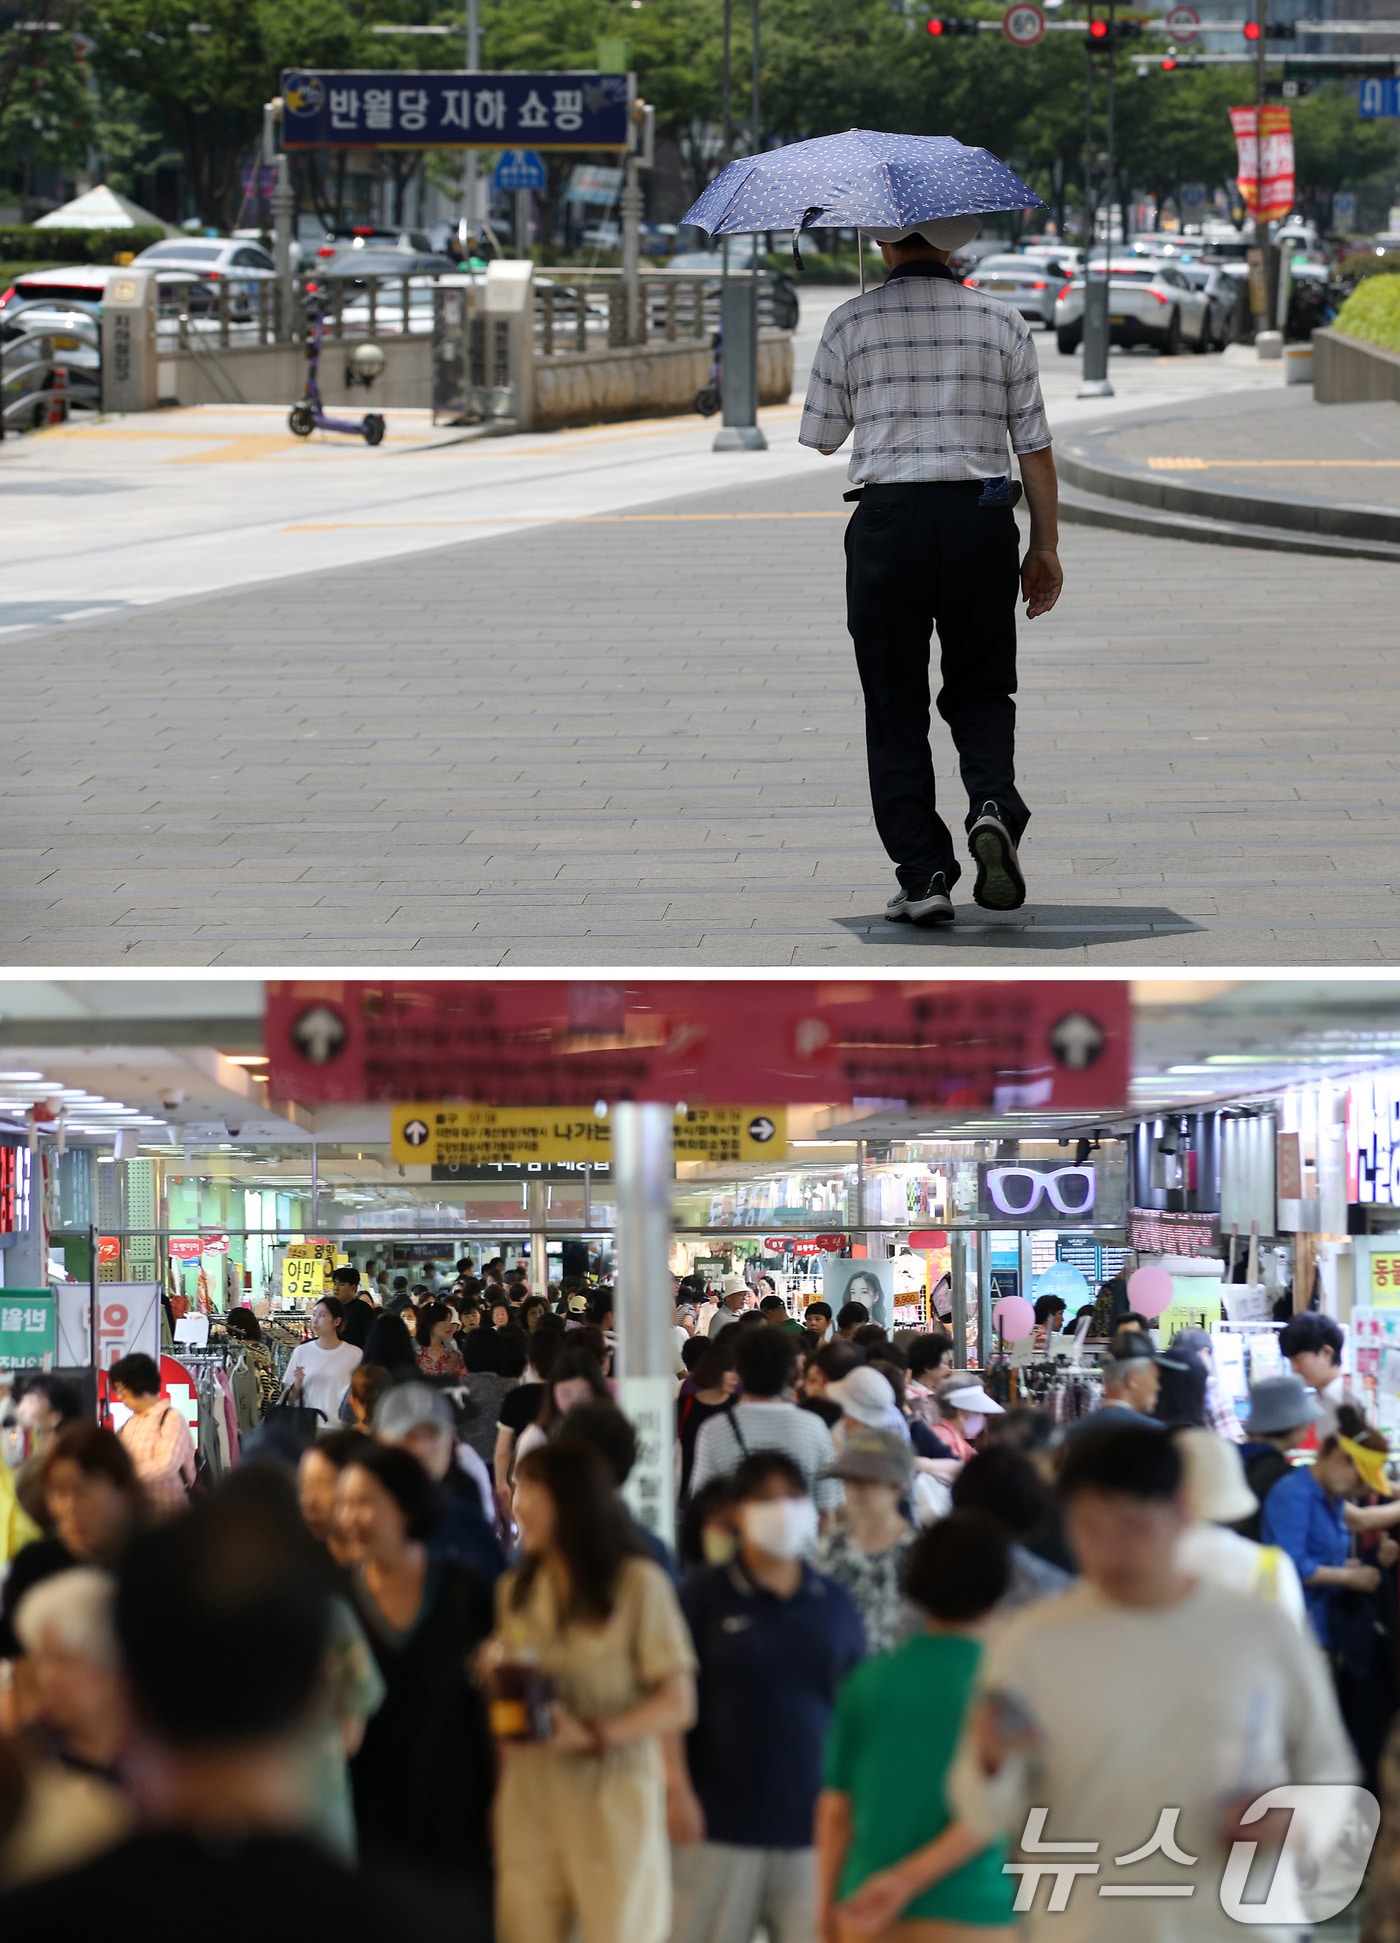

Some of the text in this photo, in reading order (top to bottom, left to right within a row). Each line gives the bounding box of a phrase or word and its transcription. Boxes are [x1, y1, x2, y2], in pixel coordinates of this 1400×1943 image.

[329, 88, 429, 132] 반월당
[440, 88, 507, 131] 지하
[517, 87, 584, 132] 쇼핑
[554, 1122, 612, 1141] 나가는
